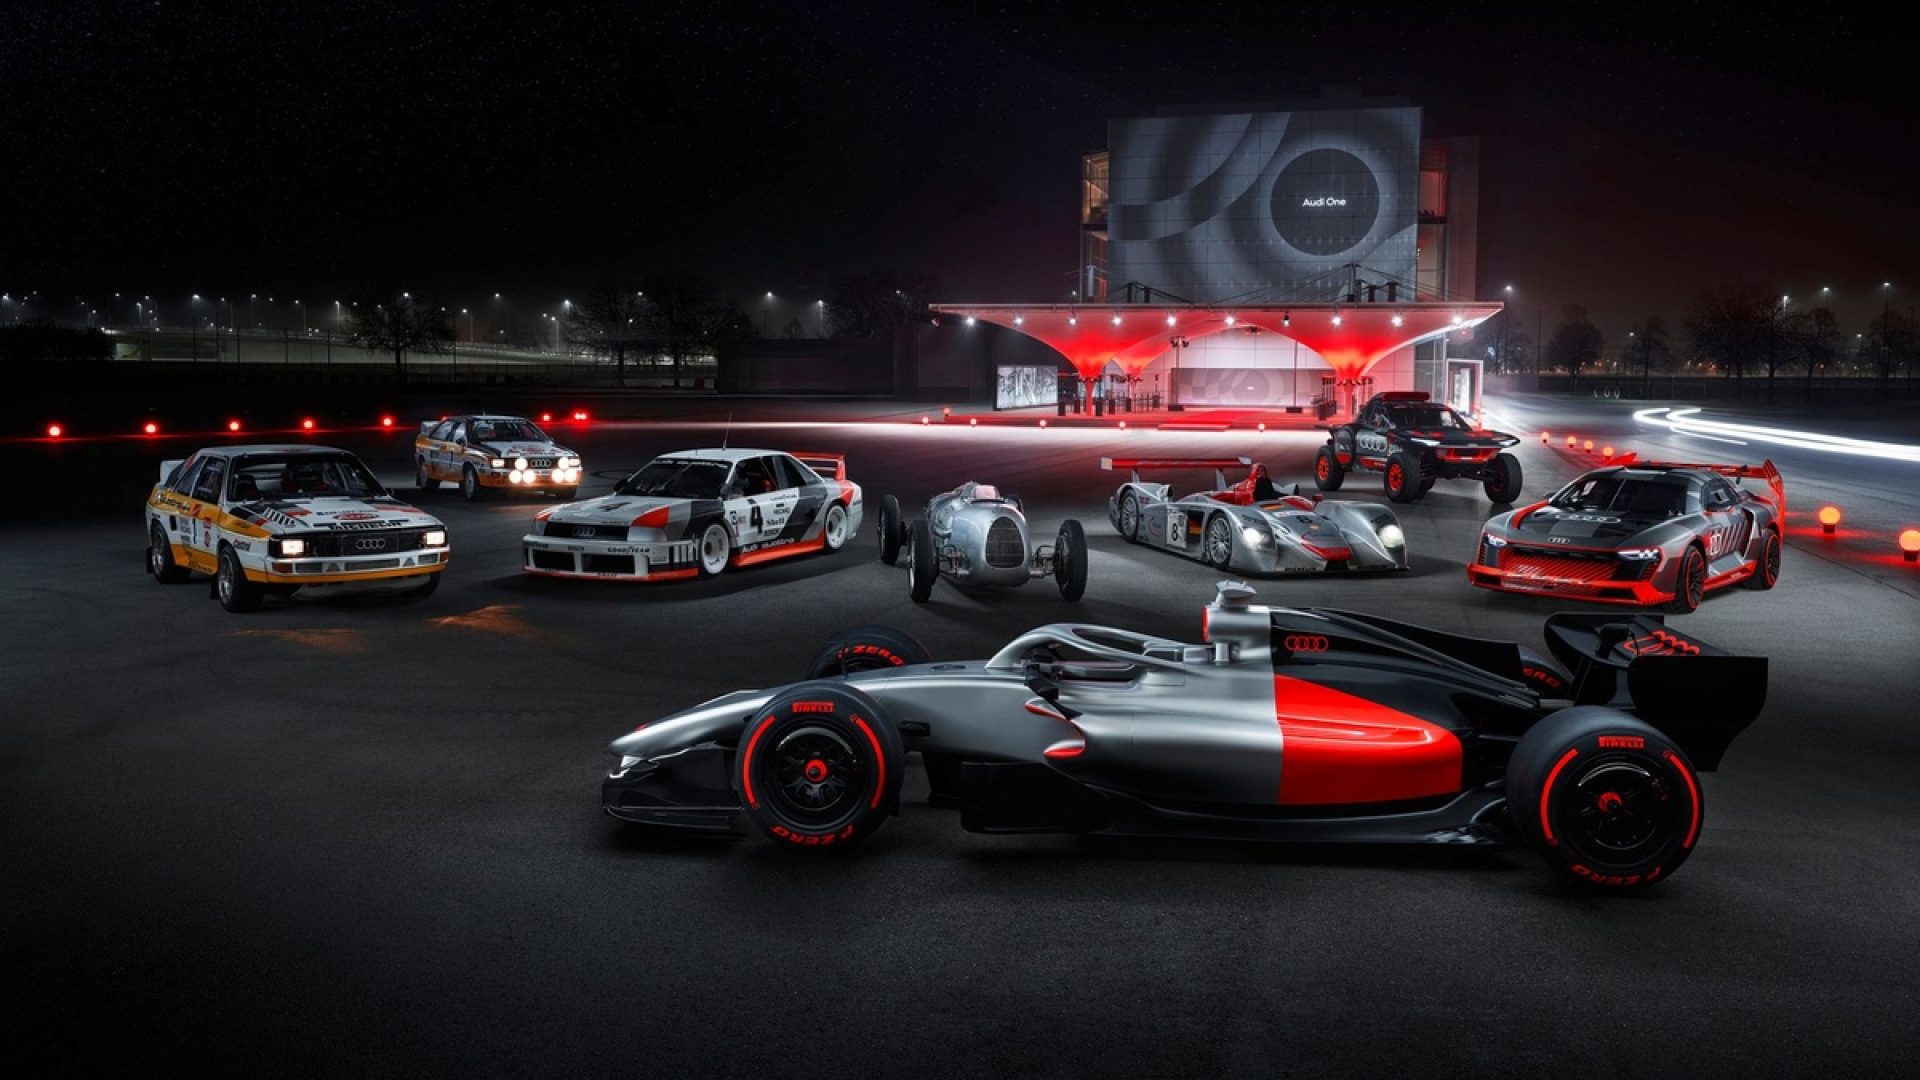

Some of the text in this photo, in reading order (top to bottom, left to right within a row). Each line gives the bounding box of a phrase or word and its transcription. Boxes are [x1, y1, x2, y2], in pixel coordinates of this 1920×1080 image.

[1302, 197, 1346, 207] Audi One
[750, 506, 764, 534] 4
[766, 517, 785, 526] Shell
[1171, 522, 1179, 541] 8
[607, 545, 651, 555] GOODYEAR
[760, 537, 796, 550] quattro
[852, 644, 905, 668] ZERO
[1522, 667, 1561, 688] ERO
[792, 701, 834, 713] PIRELLI
[1598, 735, 1644, 749] PIRELLI
[770, 823, 855, 846] P ZERO
[1569, 863, 1662, 885] P ZERO
